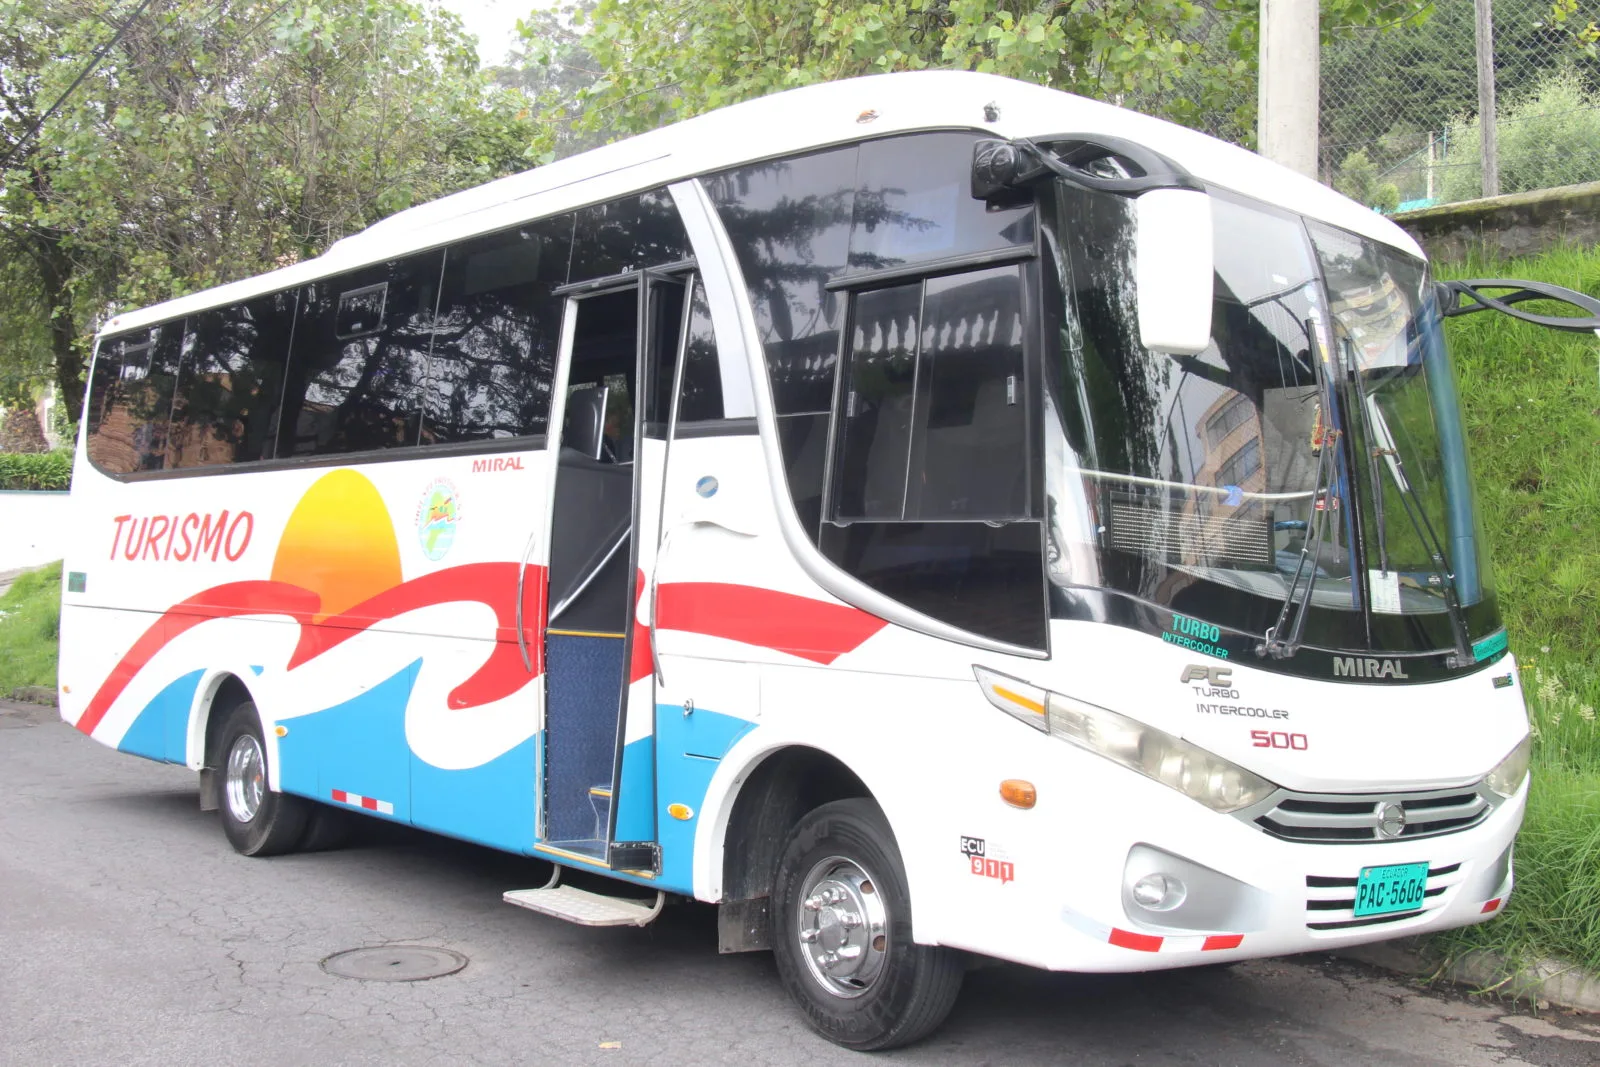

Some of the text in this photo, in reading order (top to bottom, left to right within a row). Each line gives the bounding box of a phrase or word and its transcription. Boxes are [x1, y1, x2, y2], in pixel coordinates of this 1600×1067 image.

[472, 457, 525, 473] MIRAL
[110, 509, 254, 562] TURISMO
[1172, 614, 1220, 643] TURBO
[1162, 631, 1229, 659] INTERCOOLER
[1180, 664, 1232, 688] FC
[1333, 656, 1408, 679] MIRAL
[1192, 686, 1240, 700] TURBO
[1196, 703, 1289, 720] INTERCOOLER
[1250, 730, 1308, 751] 500
[961, 838, 985, 854] ECU
[973, 858, 1011, 879] 911
[1358, 879, 1423, 909] PAC-5606
